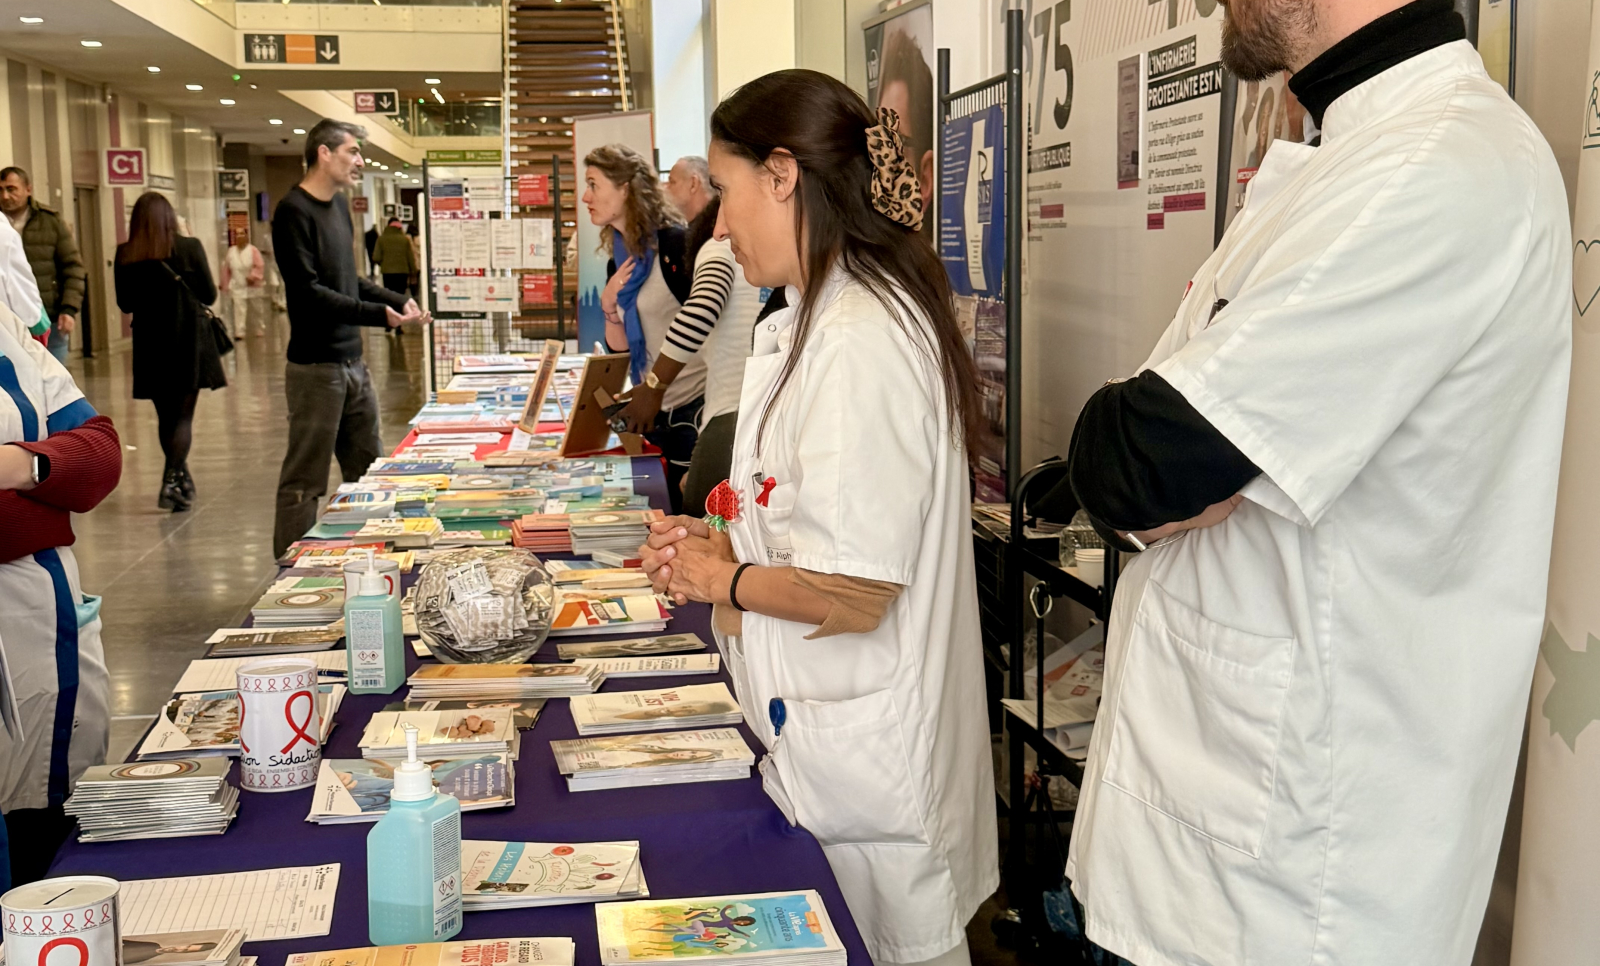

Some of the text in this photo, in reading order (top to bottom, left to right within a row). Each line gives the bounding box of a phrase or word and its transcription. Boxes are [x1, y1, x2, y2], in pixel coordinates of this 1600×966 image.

[1148, 41, 1196, 76] L'INFIRMERIE
[1148, 75, 1198, 108] PROTESTANTE
[1199, 70, 1214, 94] EST
[356, 95, 375, 107] C2
[112, 155, 140, 174] C1
[1046, 146, 1071, 168] PUBLIQUE
[235, 174, 247, 190] 2
[774, 907, 794, 942] cinquante ans
[461, 944, 482, 963] TOUS
[494, 948, 509, 963] NOUS
[518, 946, 530, 964] REGARD
[531, 941, 544, 961] CHANGER
